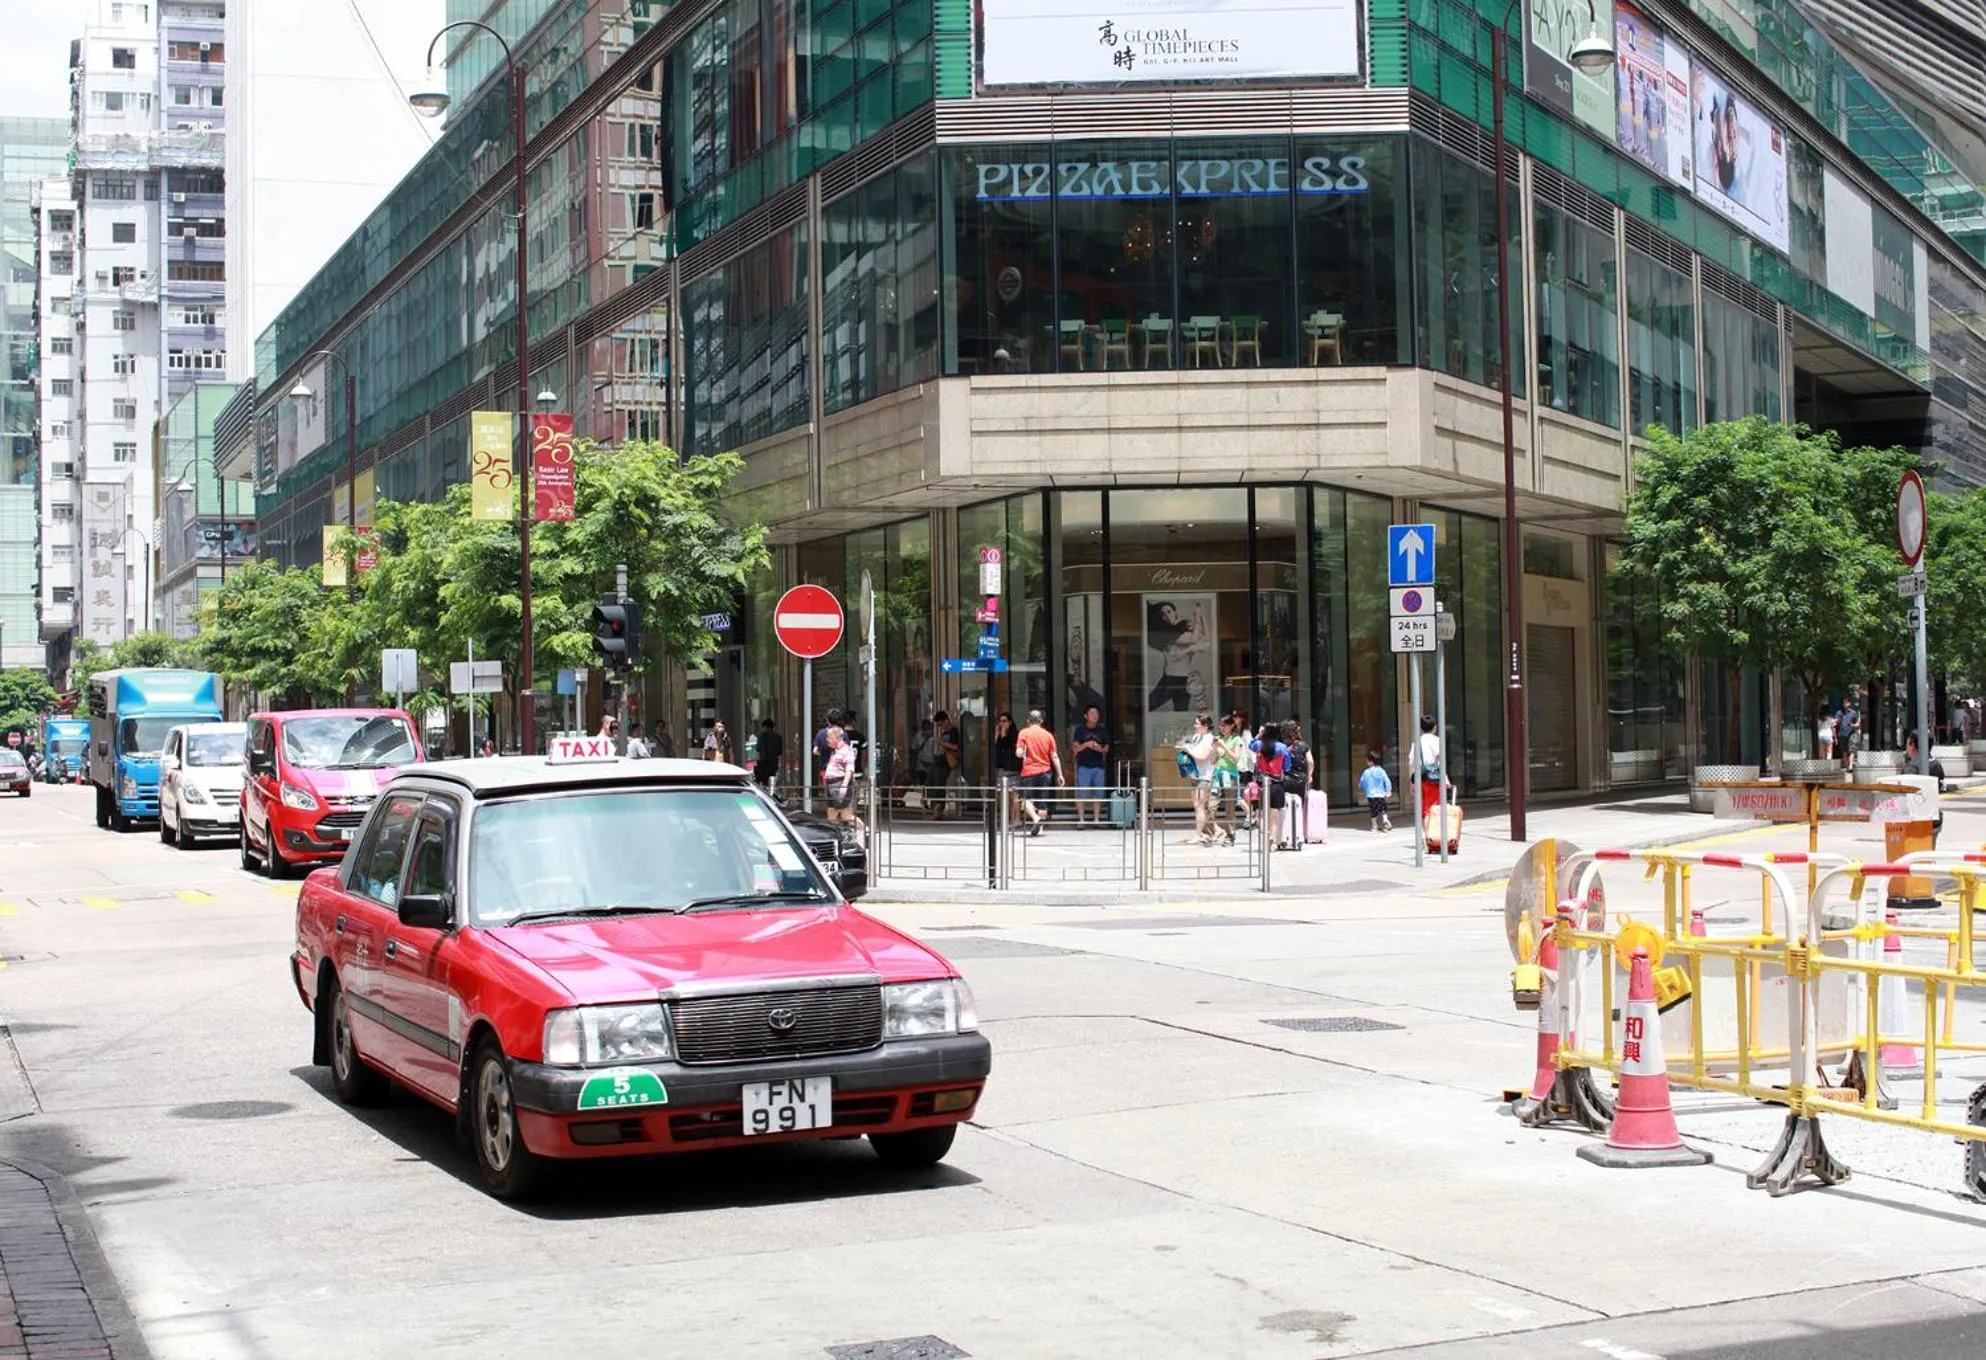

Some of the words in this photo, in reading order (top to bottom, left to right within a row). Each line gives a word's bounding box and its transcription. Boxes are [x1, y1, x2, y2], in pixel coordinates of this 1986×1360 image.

[1123, 28, 1193, 43] GLOBAL
[1143, 39, 1240, 55] TIMEPIECES
[534, 425, 574, 464] 25
[473, 451, 512, 489] 25
[1398, 621, 1411, 631] 24
[1412, 621, 1428, 630] hrs
[1401, 634, 1424, 648] 全日
[559, 741, 609, 758] TAXI
[1622, 1015, 1645, 1064] 和興
[613, 1075, 632, 1095] 5
[767, 1078, 807, 1107] FN
[596, 1092, 650, 1107] SEATS
[751, 1103, 817, 1135] 991
